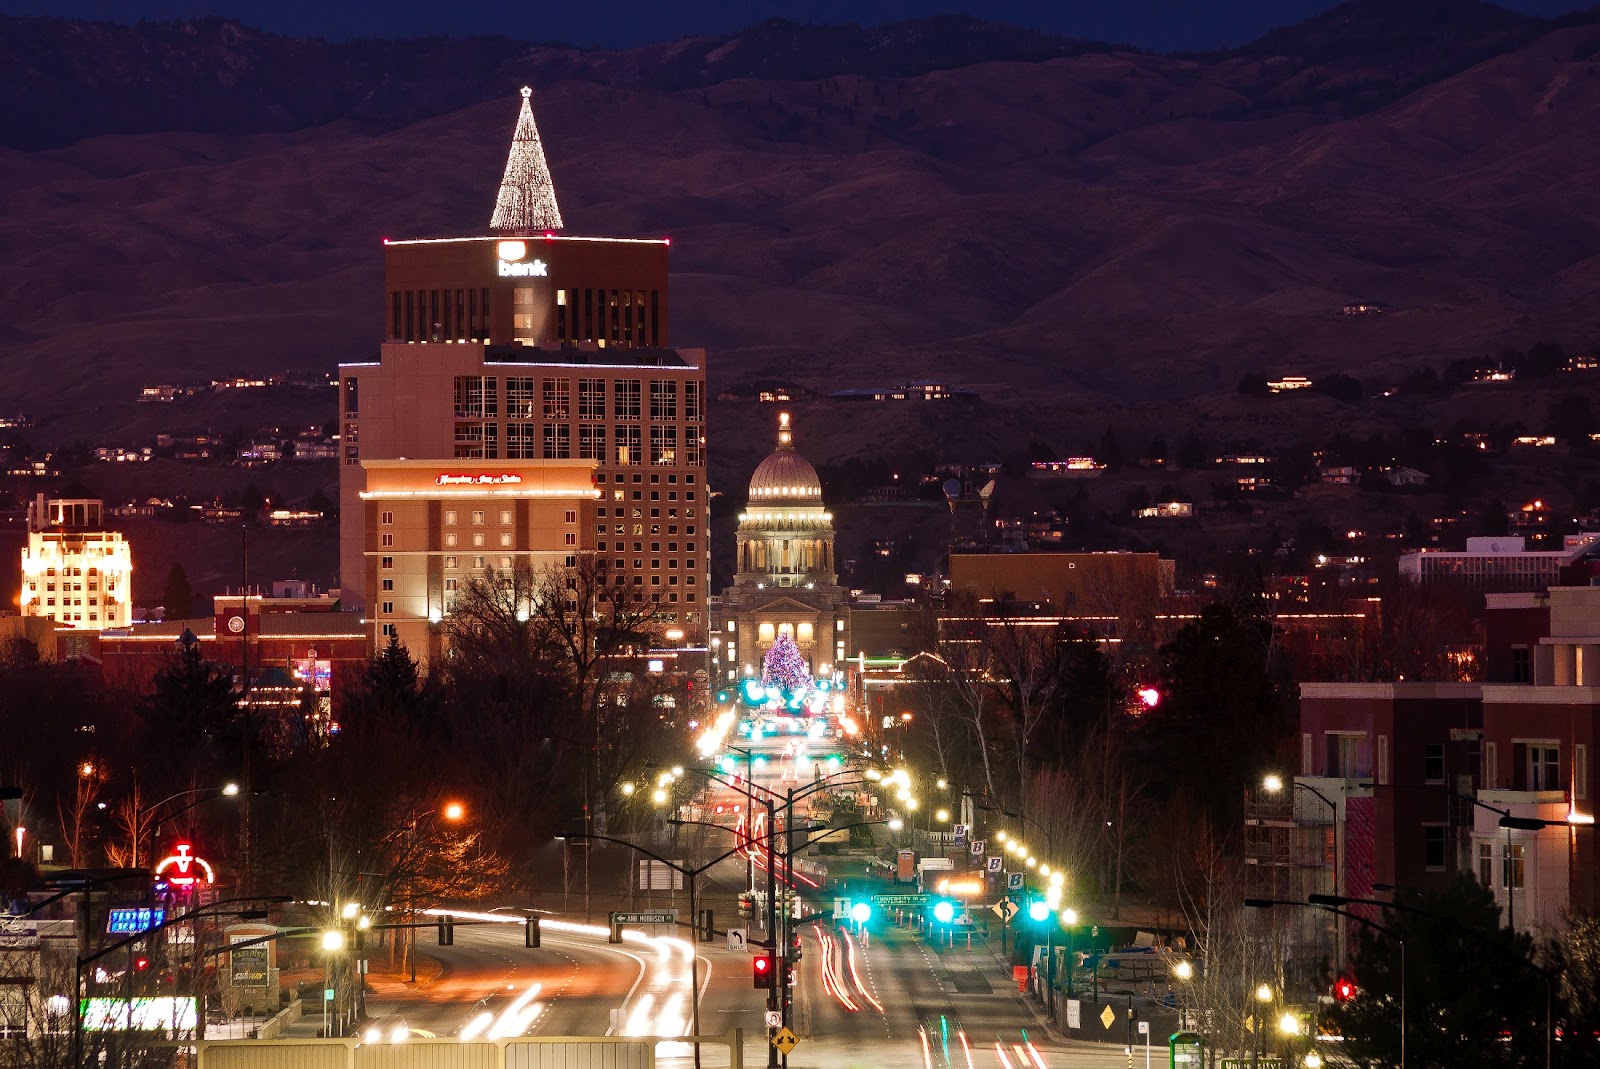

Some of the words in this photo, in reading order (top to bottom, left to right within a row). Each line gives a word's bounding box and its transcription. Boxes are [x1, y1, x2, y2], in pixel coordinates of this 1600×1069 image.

[498, 259, 548, 277] bank
[973, 841, 983, 853] B
[989, 858, 1001, 870] B
[1009, 873, 1022, 887] B
[639, 915, 665, 923] MORRISON
